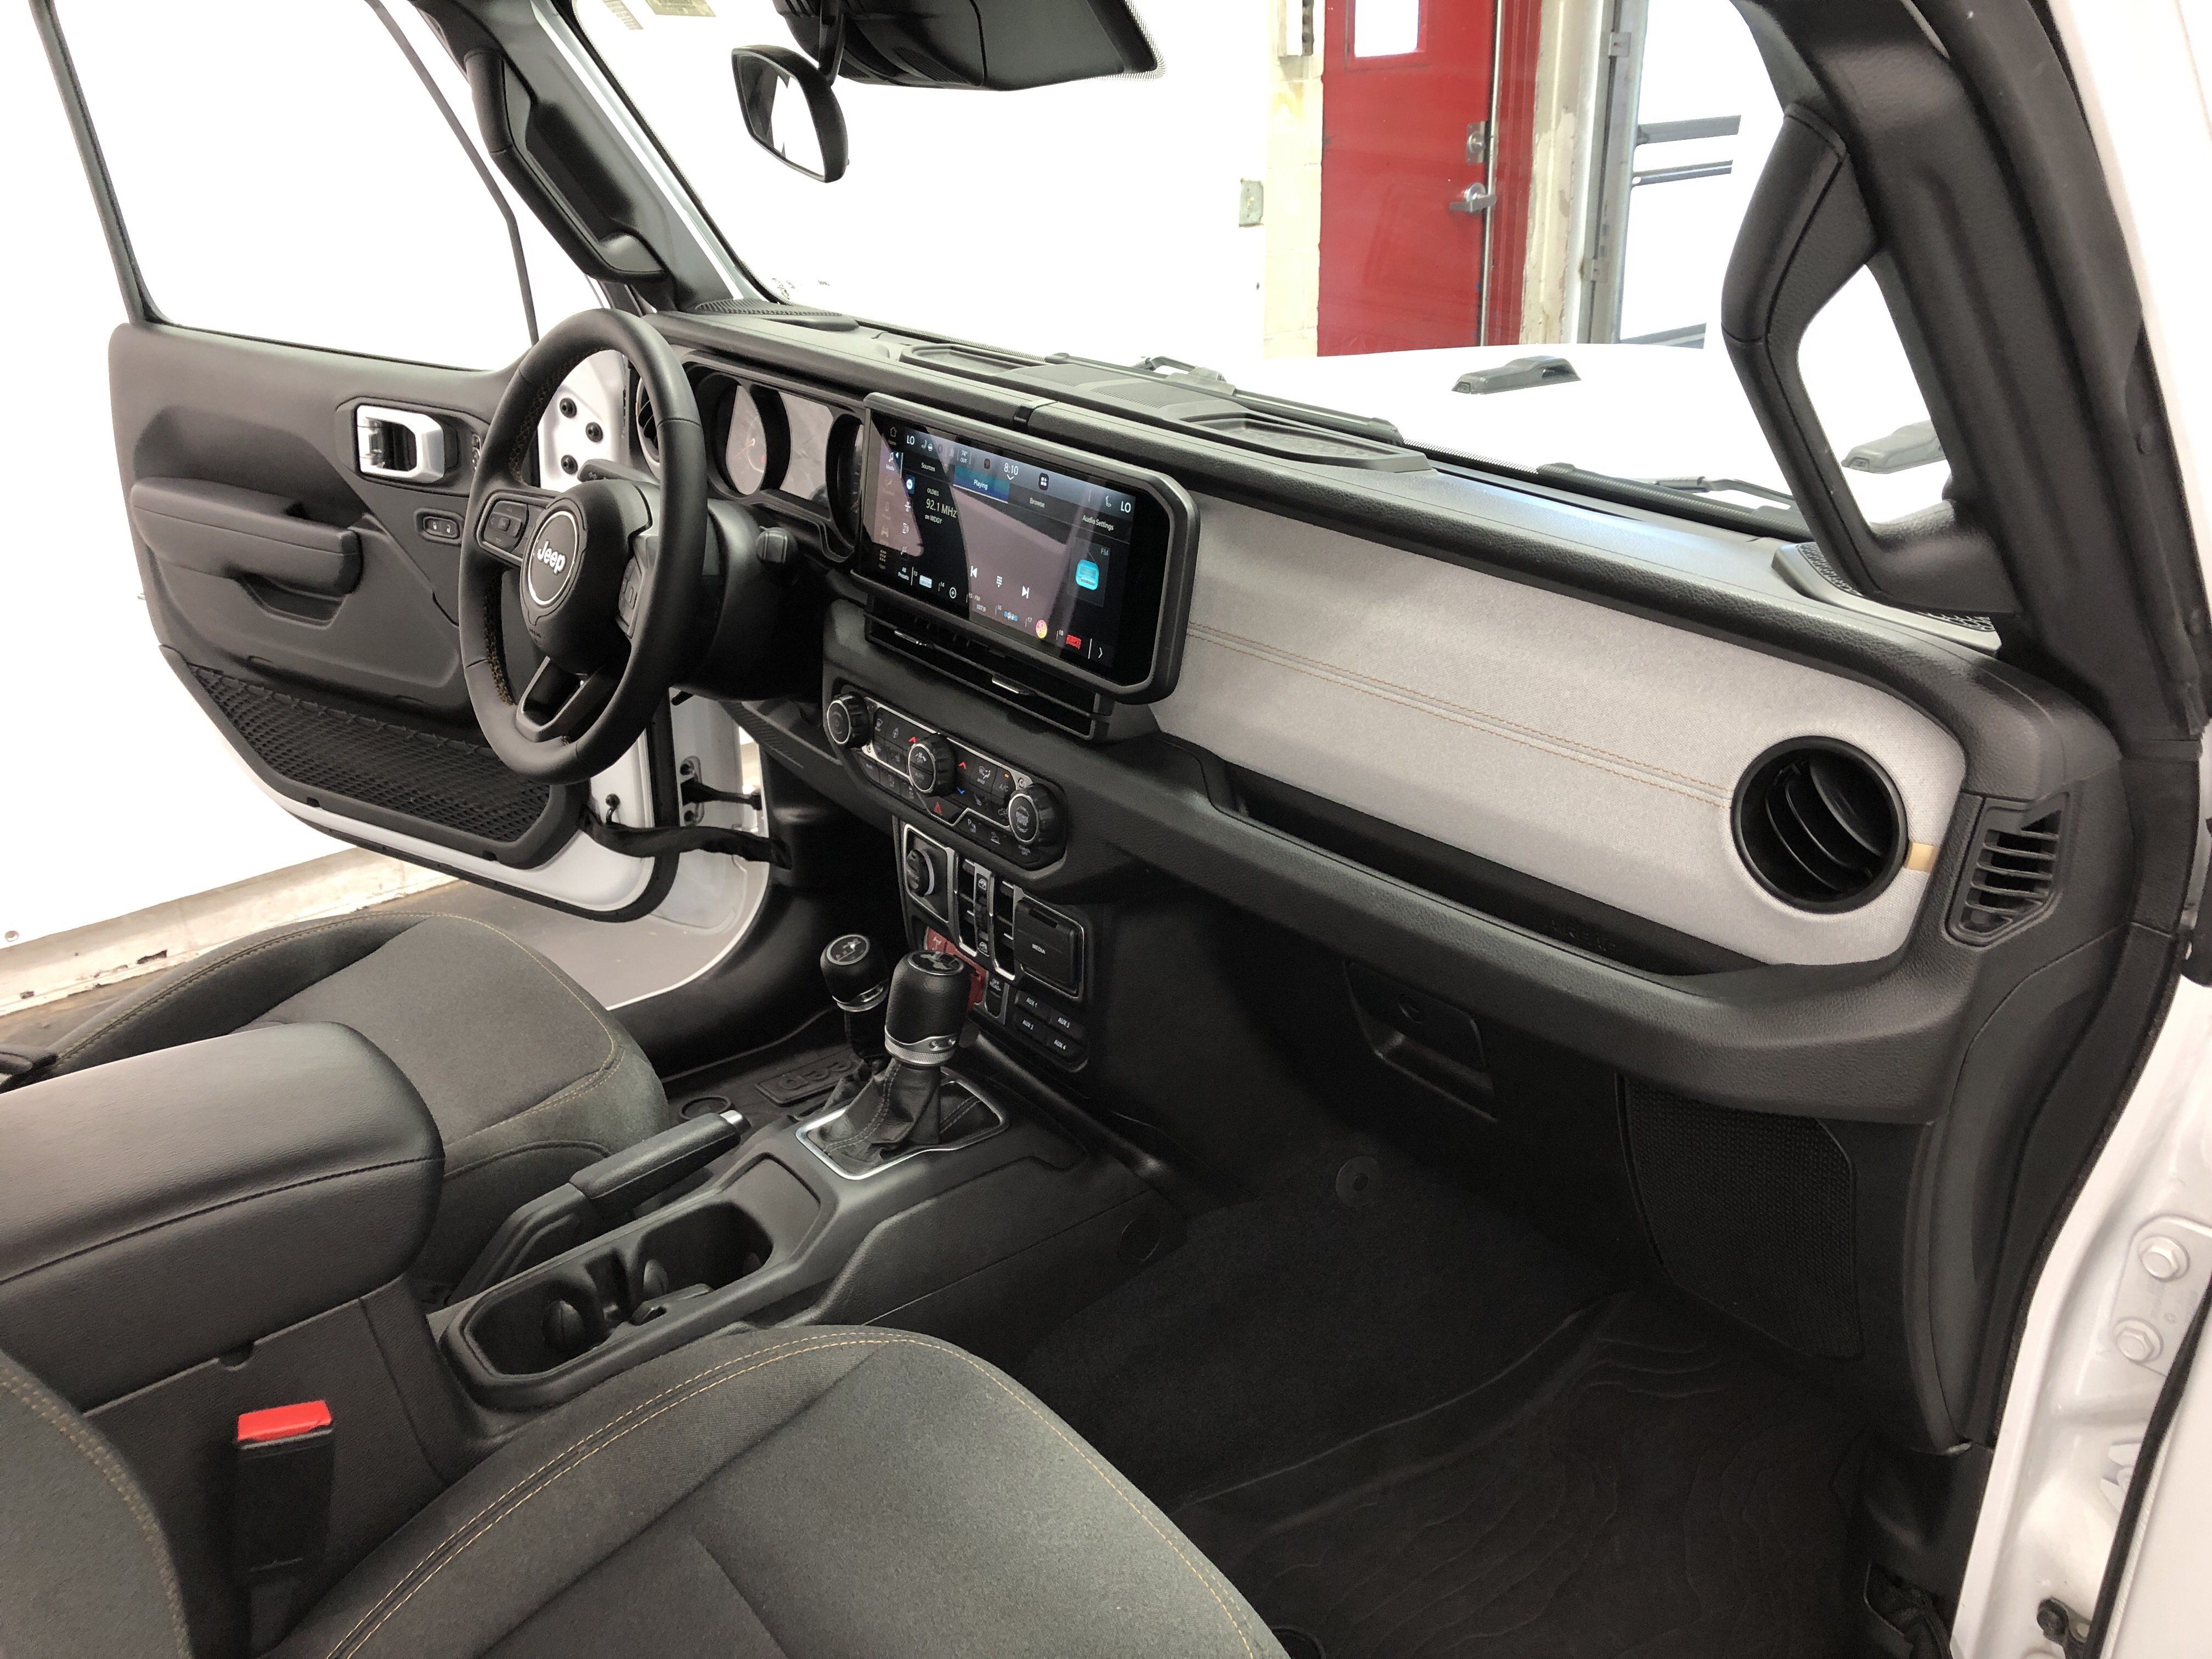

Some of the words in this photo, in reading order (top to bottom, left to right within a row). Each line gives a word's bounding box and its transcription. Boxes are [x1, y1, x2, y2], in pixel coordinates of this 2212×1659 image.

[907, 435, 915, 445] LO
[921, 462, 935, 472] Sources
[1003, 462, 1019, 476] 8:10
[973, 479, 988, 490] Playing
[927, 488, 939, 496] OLDIES
[926, 498, 940, 512] 92.1
[941, 503, 957, 518] MHz
[1030, 498, 1045, 508] Browse
[1120, 500, 1131, 513] LO
[1082, 515, 1096, 526] Audio
[1096, 519, 1114, 531] Settings
[1101, 548, 1109, 556] FM
[537, 540, 566, 576] Jeep
[998, 783, 1009, 792] A/C
[1032, 943, 1046, 955] MEDIA
[1026, 997, 1035, 1006] AUX
[1022, 1019, 1031, 1028] AUX
[1057, 1017, 1067, 1026] AUX
[1053, 1039, 1063, 1048] AUX
